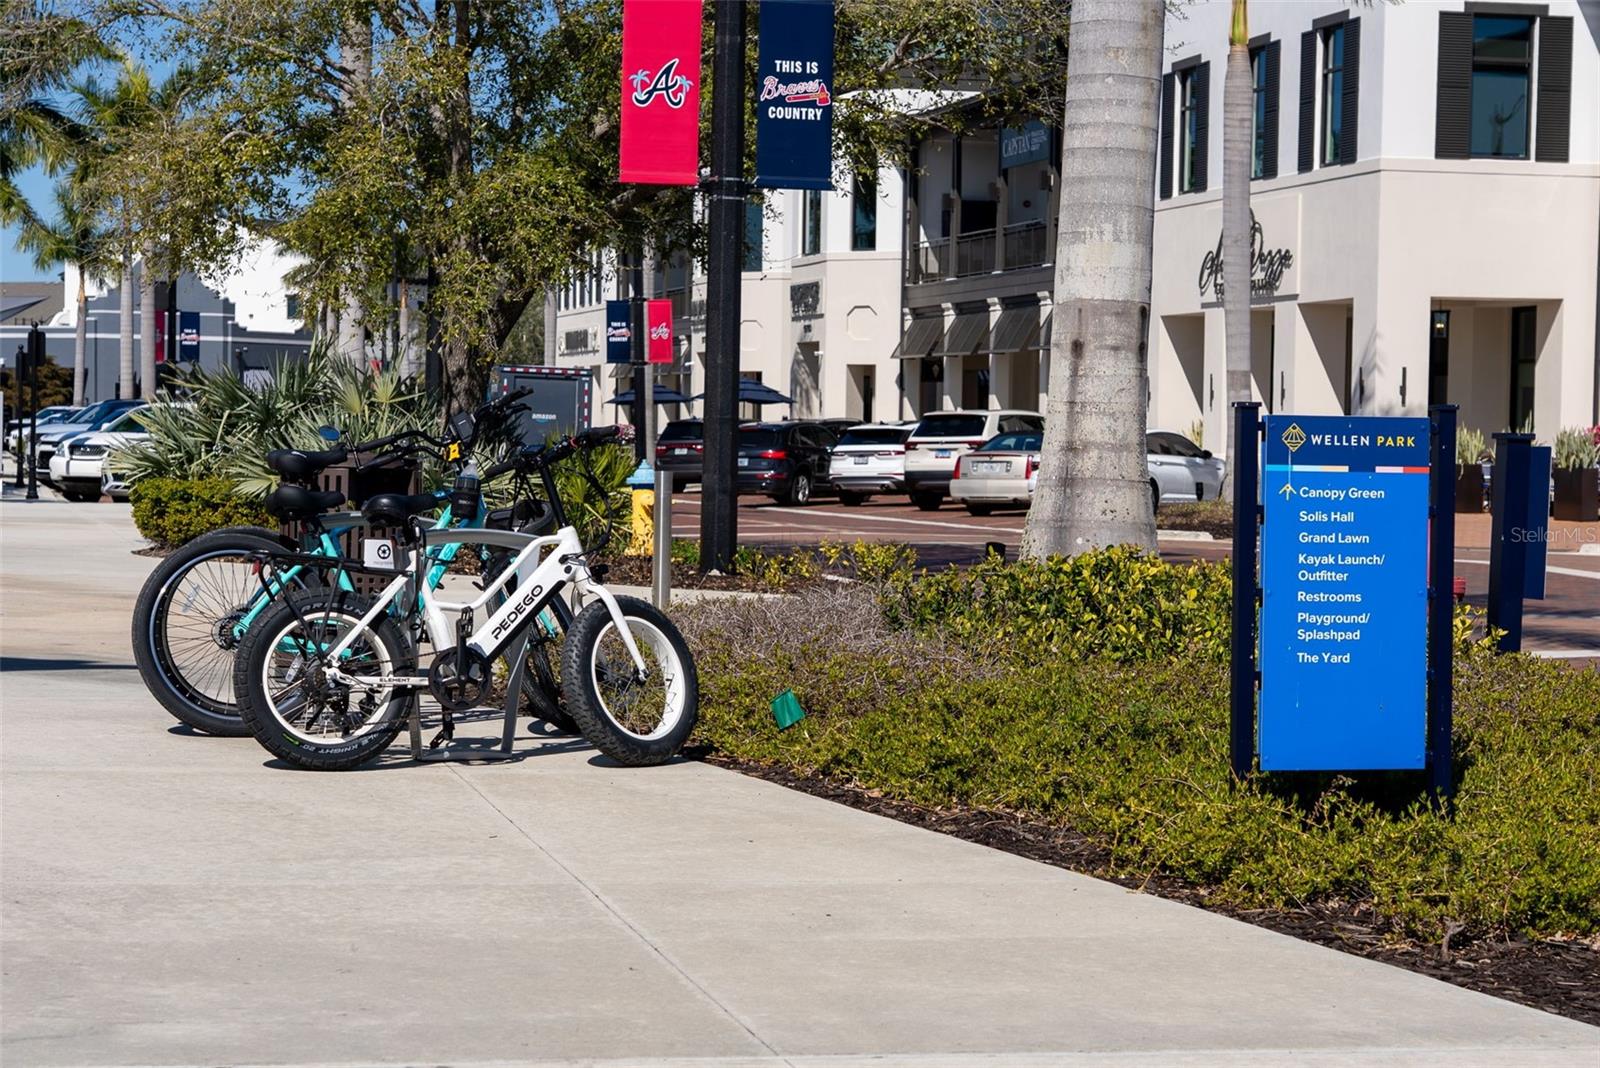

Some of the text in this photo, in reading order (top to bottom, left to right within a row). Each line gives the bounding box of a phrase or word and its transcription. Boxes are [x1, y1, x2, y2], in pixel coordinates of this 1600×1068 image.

[774, 60, 819, 74] THIS IS
[632, 58, 684, 109] A
[760, 75, 821, 101] Braves
[768, 106, 823, 121] COUNTRY
[1310, 434, 1416, 447] WELLEN PARK
[1299, 487, 1385, 501] Canopy Green
[1299, 510, 1354, 522] Solis Hall
[1299, 532, 1370, 544] Grand Lawn
[1298, 553, 1385, 567] Kayak Launch/
[1298, 570, 1349, 582] Outfitter
[1297, 591, 1362, 602] Restrooms
[491, 584, 543, 640] PEDEGO
[1297, 612, 1371, 626] Playground/
[1297, 629, 1361, 642] Splashpad
[1297, 652, 1351, 664] The Yard
